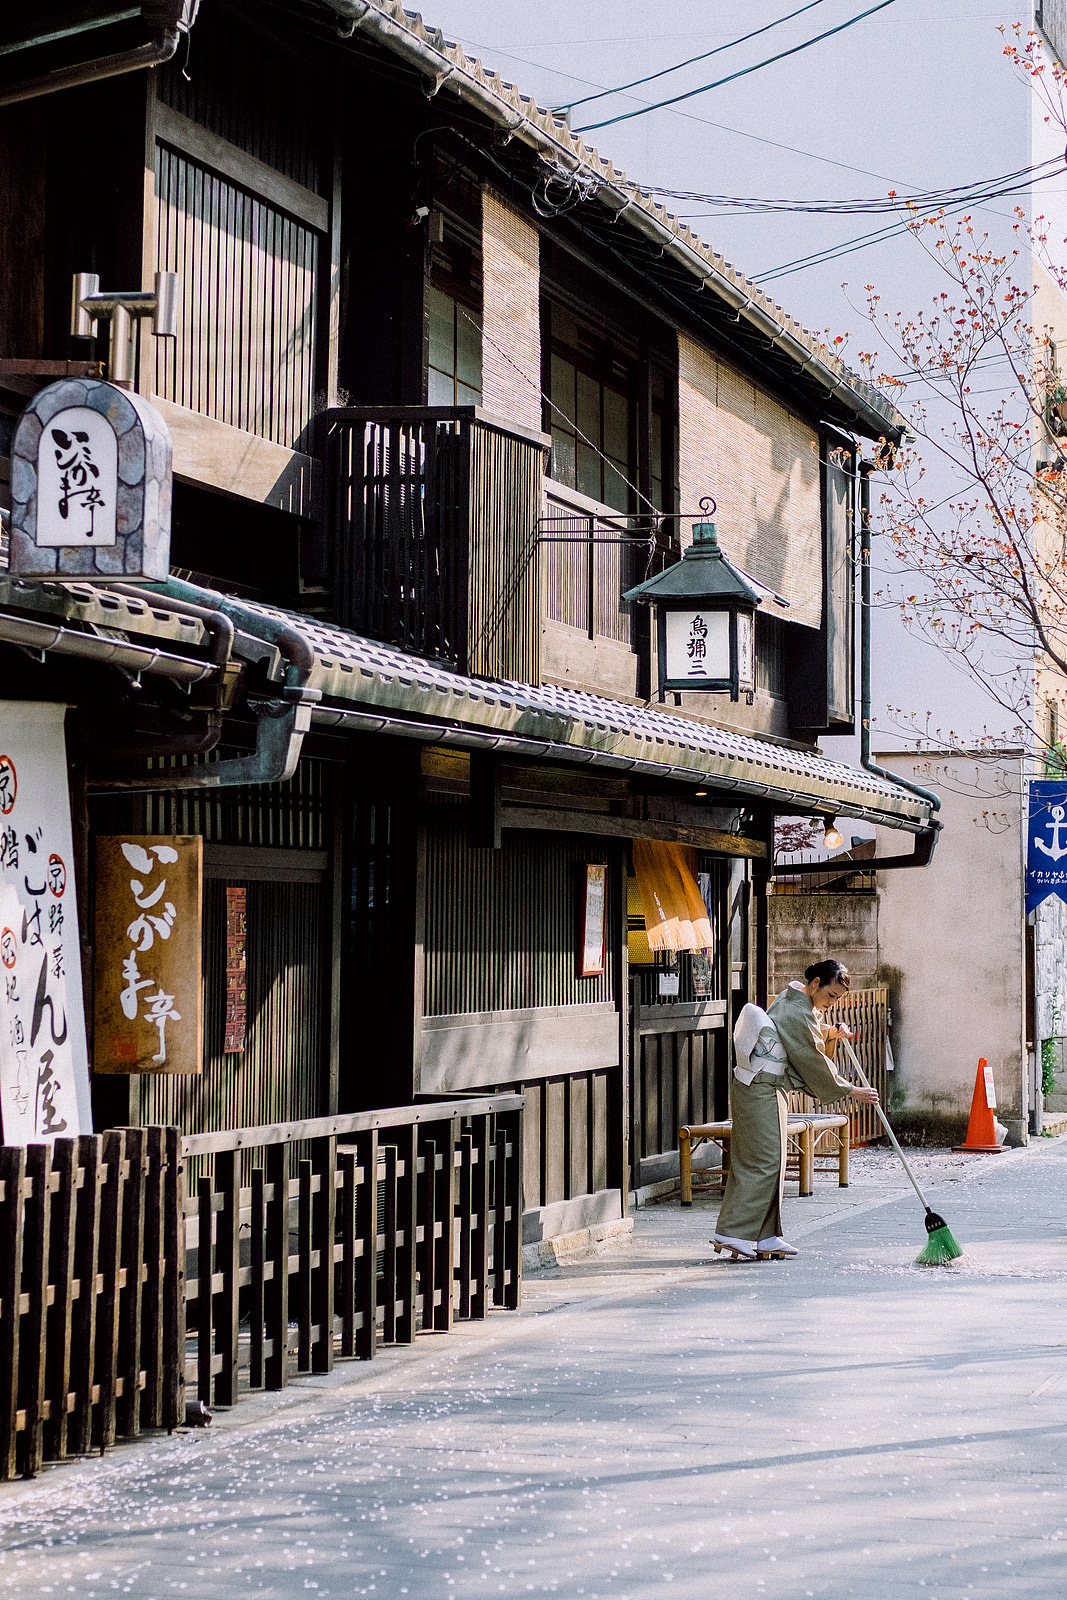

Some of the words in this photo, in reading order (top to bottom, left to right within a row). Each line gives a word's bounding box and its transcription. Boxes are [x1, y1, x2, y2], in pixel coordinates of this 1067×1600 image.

[120, 842, 182, 1063] いしがま亭
